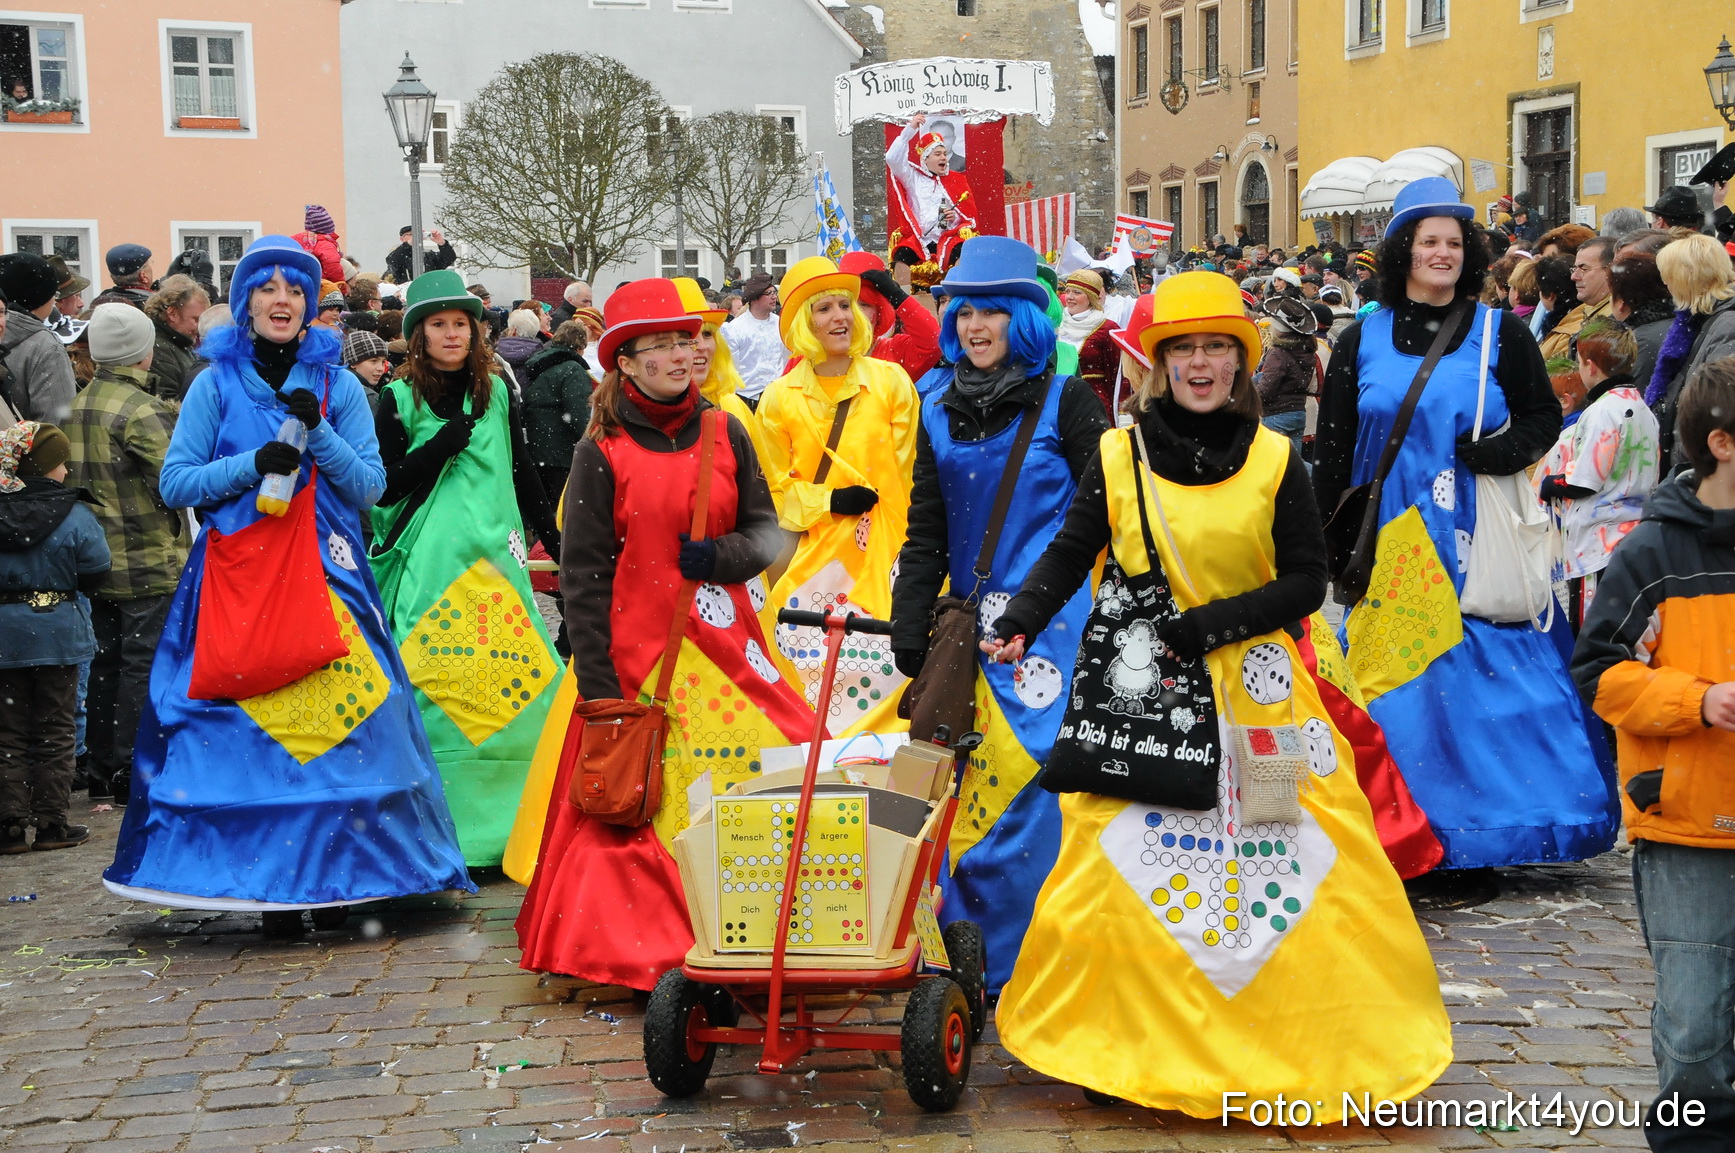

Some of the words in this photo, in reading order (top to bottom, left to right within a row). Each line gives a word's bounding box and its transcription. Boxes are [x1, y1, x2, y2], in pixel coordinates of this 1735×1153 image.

[861, 70, 915, 96] König
[923, 65, 990, 90] Ludwig
[897, 98, 916, 109] von
[922, 92, 968, 107] Bacham
[1057, 722, 1074, 742] hne
[1077, 719, 1107, 746] Dich
[1110, 729, 1130, 751] ist
[1135, 735, 1168, 757] alles
[1174, 739, 1215, 766] doof.
[731, 833, 764, 841] Mensch
[820, 832, 849, 842] ärgere
[740, 905, 760, 914] Dich
[826, 904, 848, 912] nicht
